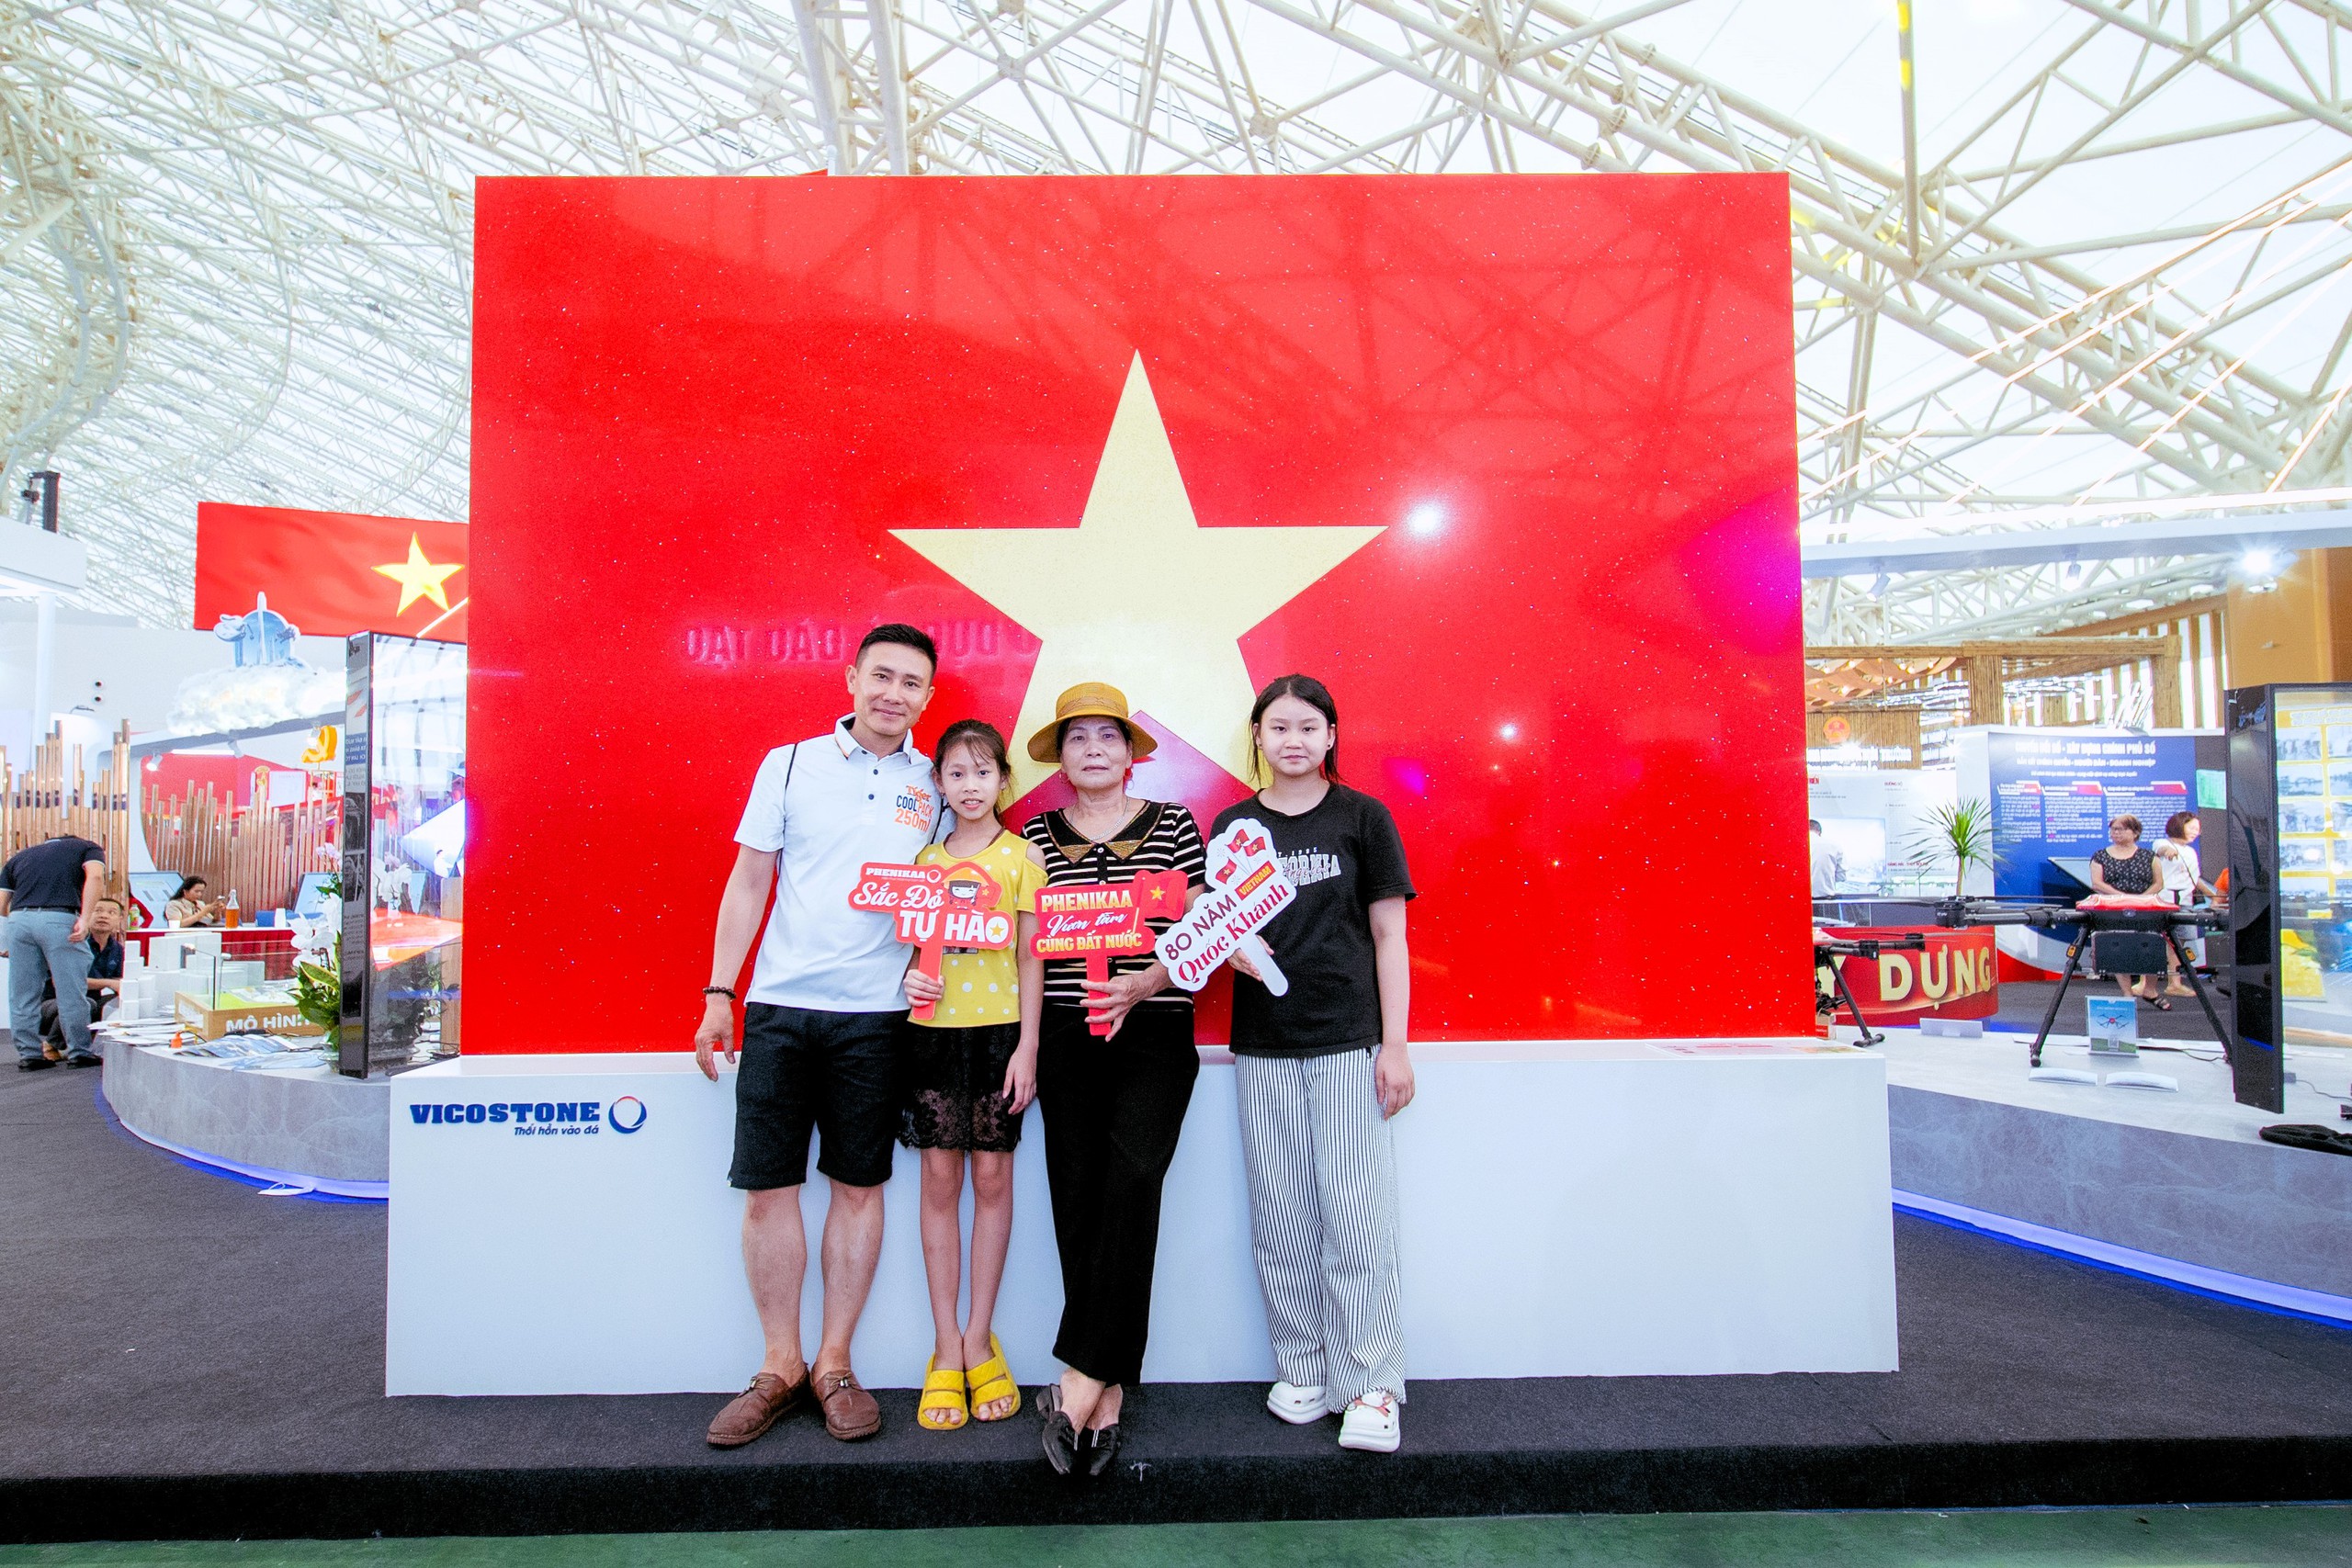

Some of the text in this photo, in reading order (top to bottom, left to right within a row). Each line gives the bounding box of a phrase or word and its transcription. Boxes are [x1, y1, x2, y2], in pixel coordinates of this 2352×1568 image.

[895, 808, 931, 832] 250ml
[865, 867, 926, 879] PHENIKAA
[1238, 865, 1272, 897] VIETNAM
[854, 882, 944, 909] Sắc Đỏ
[1041, 890, 1133, 913] PHENIKAA
[899, 909, 1009, 943] TỰ HÀO
[1165, 894, 1237, 960] 80 NĂM
[1178, 884, 1289, 983] Quốc Khánh
[1036, 929, 1142, 953] CÙNG ĐẤT NƯỚC
[1879, 943, 1991, 1010] DỰNG
[226, 1014, 258, 1032] MÔ
[410, 1101, 600, 1124] VICOSTONE
[514, 1123, 536, 1135] Thổi
[561, 1125, 581, 1135] vào
[583, 1124, 599, 1135] đá
